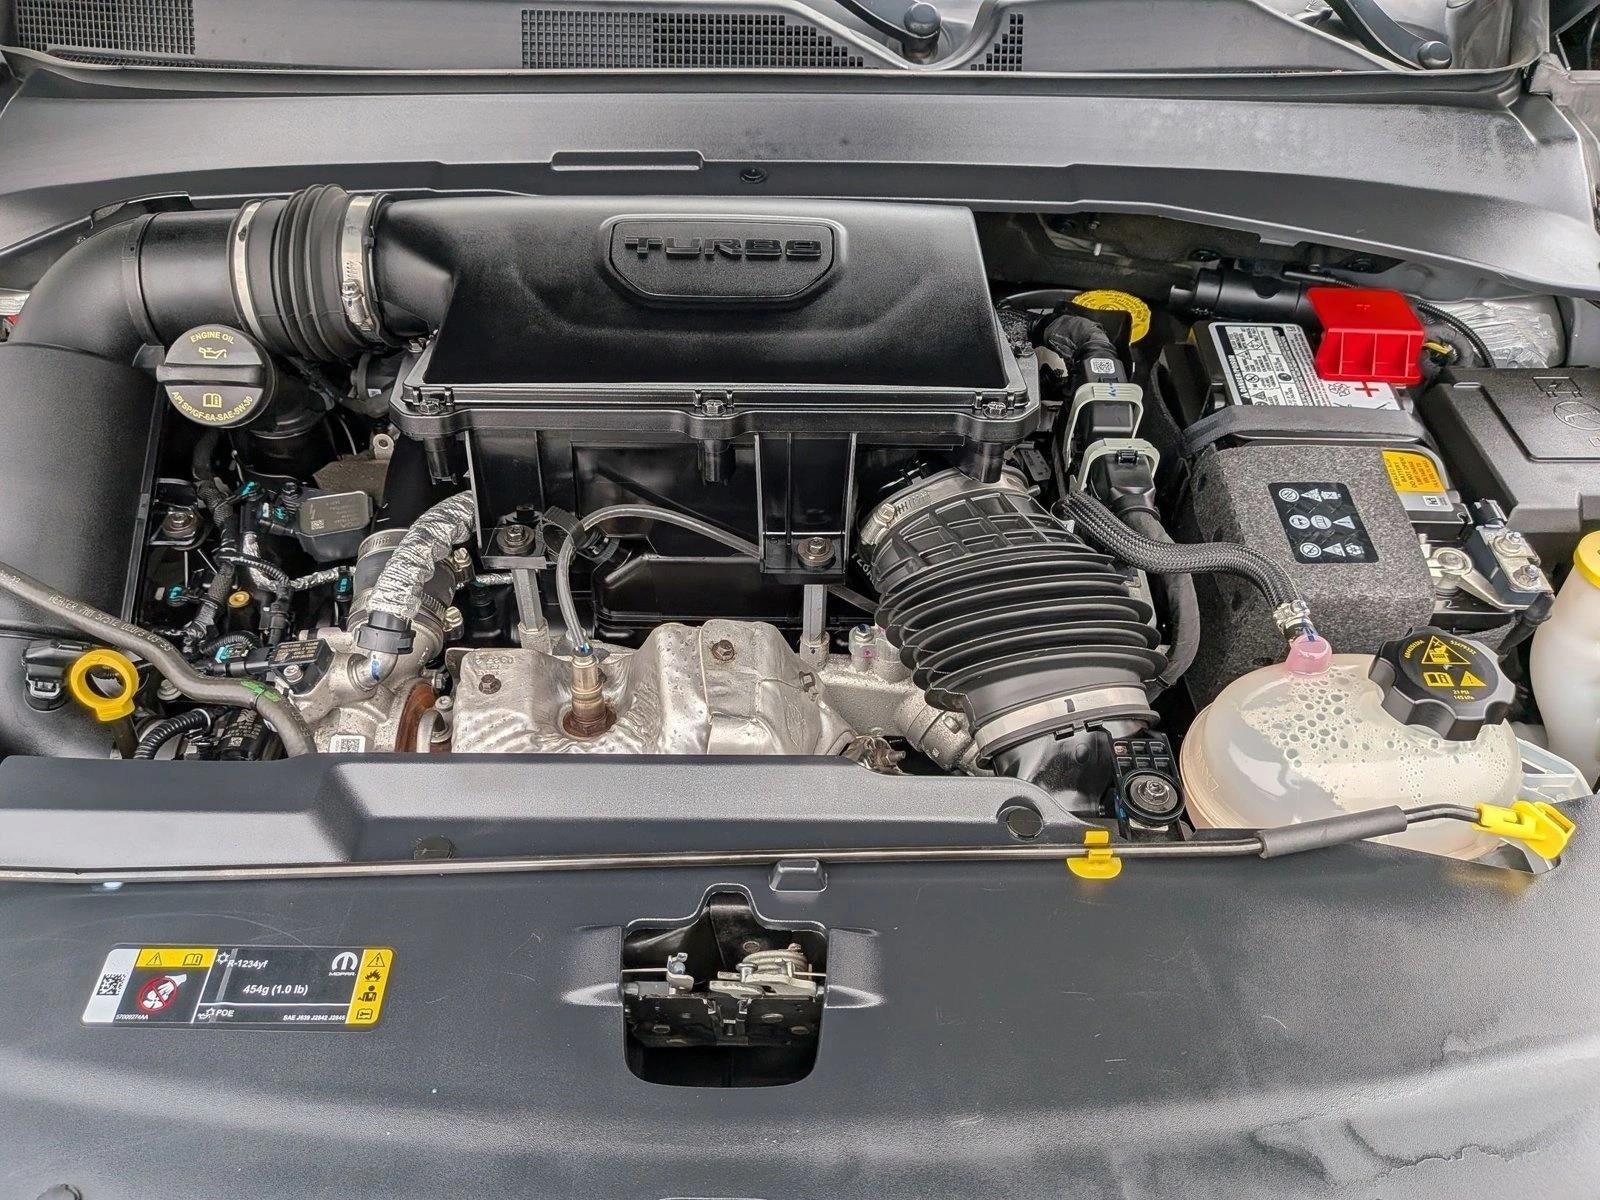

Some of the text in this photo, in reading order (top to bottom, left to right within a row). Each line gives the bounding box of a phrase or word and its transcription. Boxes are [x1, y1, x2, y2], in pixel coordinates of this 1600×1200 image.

[624, 236, 822, 258] TURBO
[190, 331, 234, 344] ENGINE OIL
[172, 391, 184, 405] API
[227, 959, 269, 970] R-1234yf
[243, 984, 309, 996] 454g (1.0 lb)
[215, 1009, 235, 1018] POE
